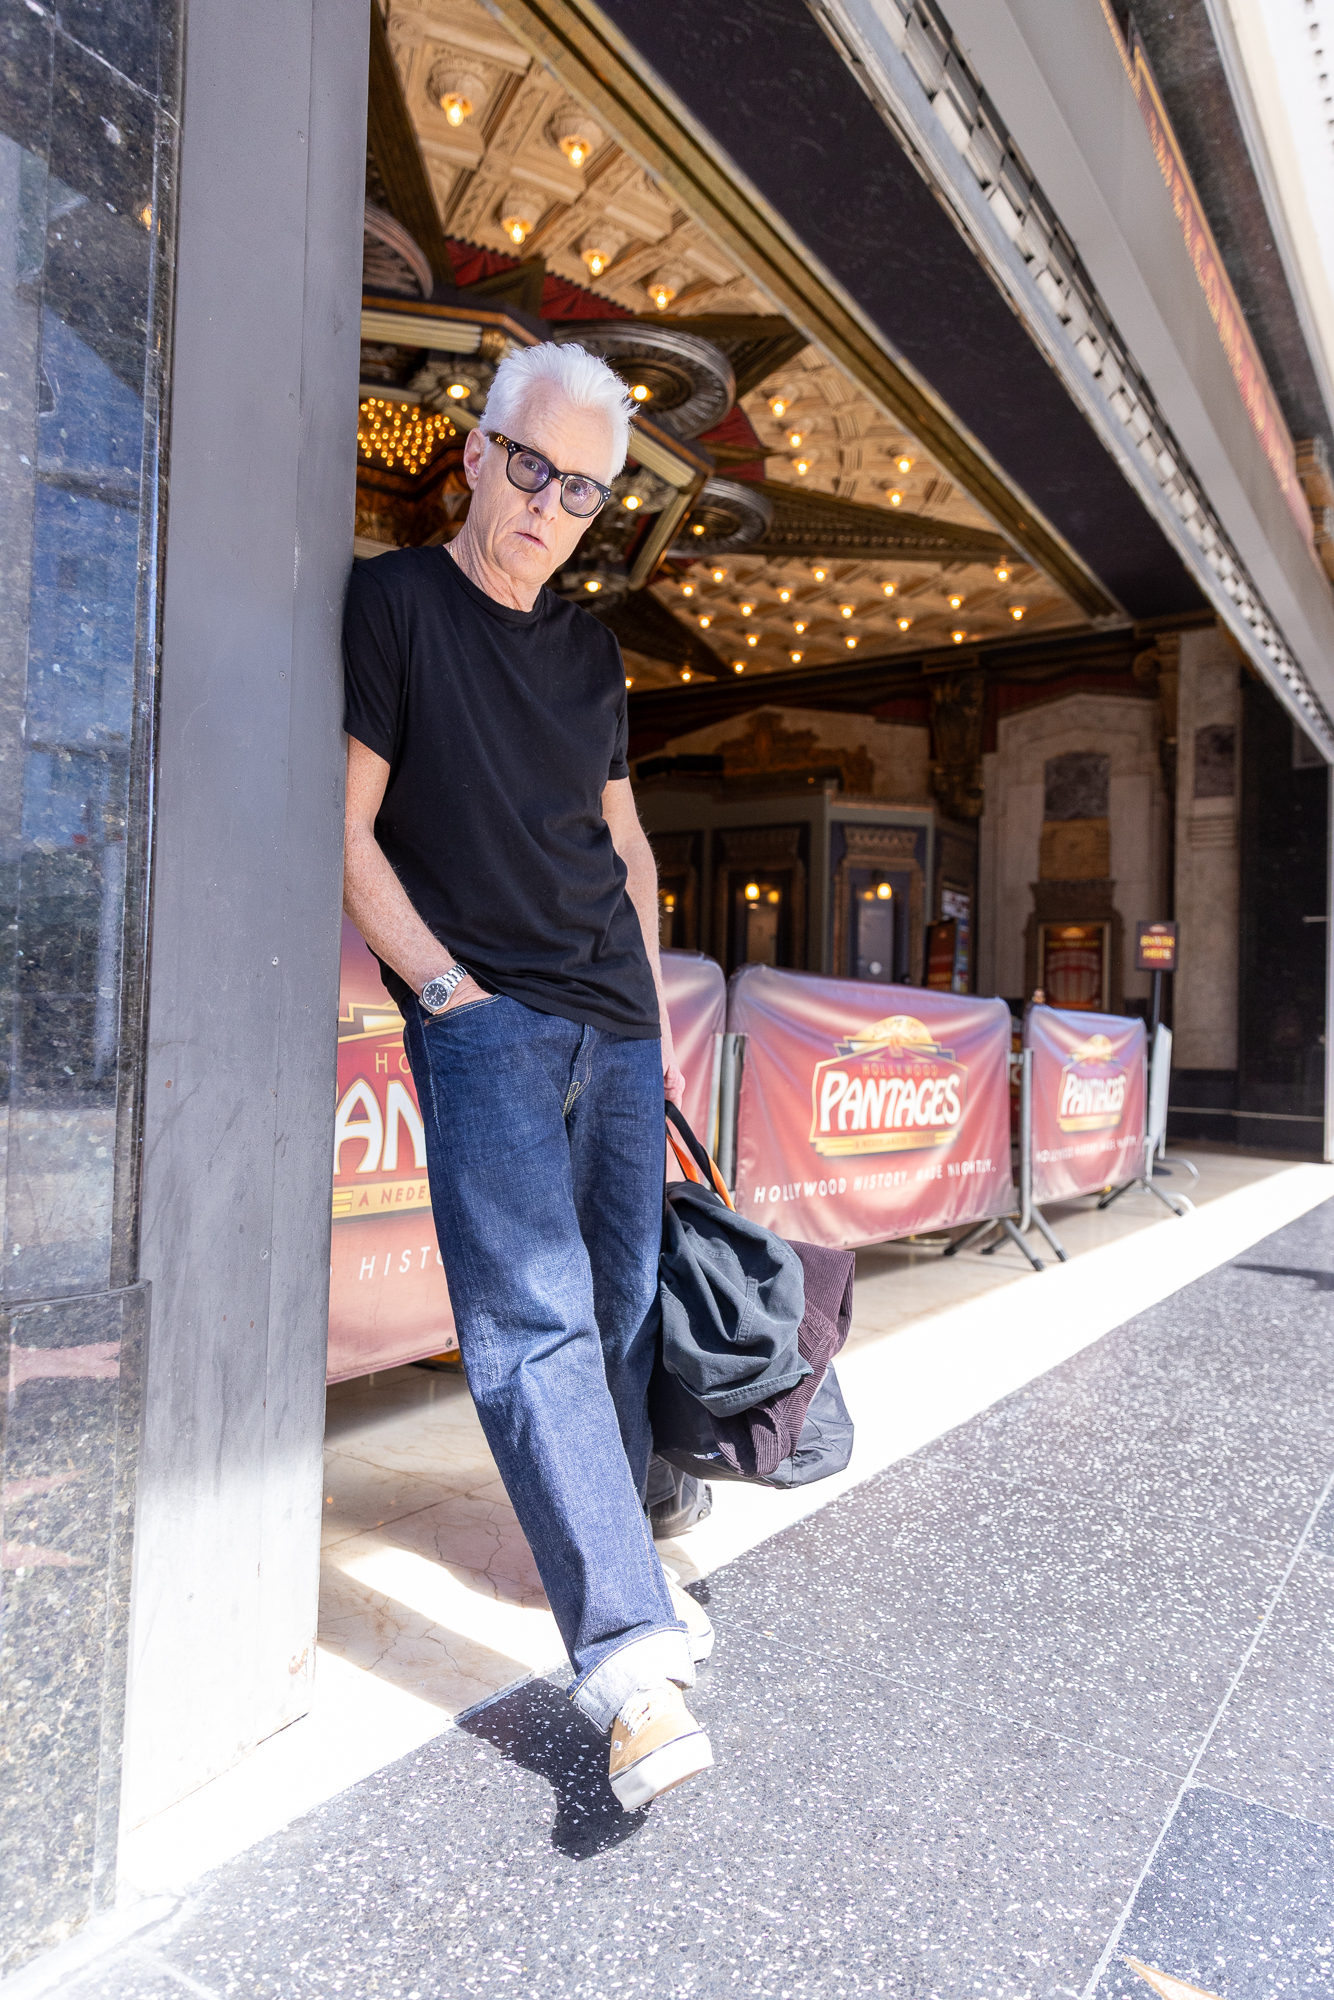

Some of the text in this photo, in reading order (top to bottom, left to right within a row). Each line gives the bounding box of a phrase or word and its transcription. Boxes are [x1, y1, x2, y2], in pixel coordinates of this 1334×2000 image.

[861, 1062, 938, 1077] HOLLYWOOD
[819, 1070, 961, 1132] PANTAGES
[333, 1078, 427, 1175] AN
[358, 1185, 431, 1208] A NEDE
[753, 1177, 847, 1204] HOLLYWOOD
